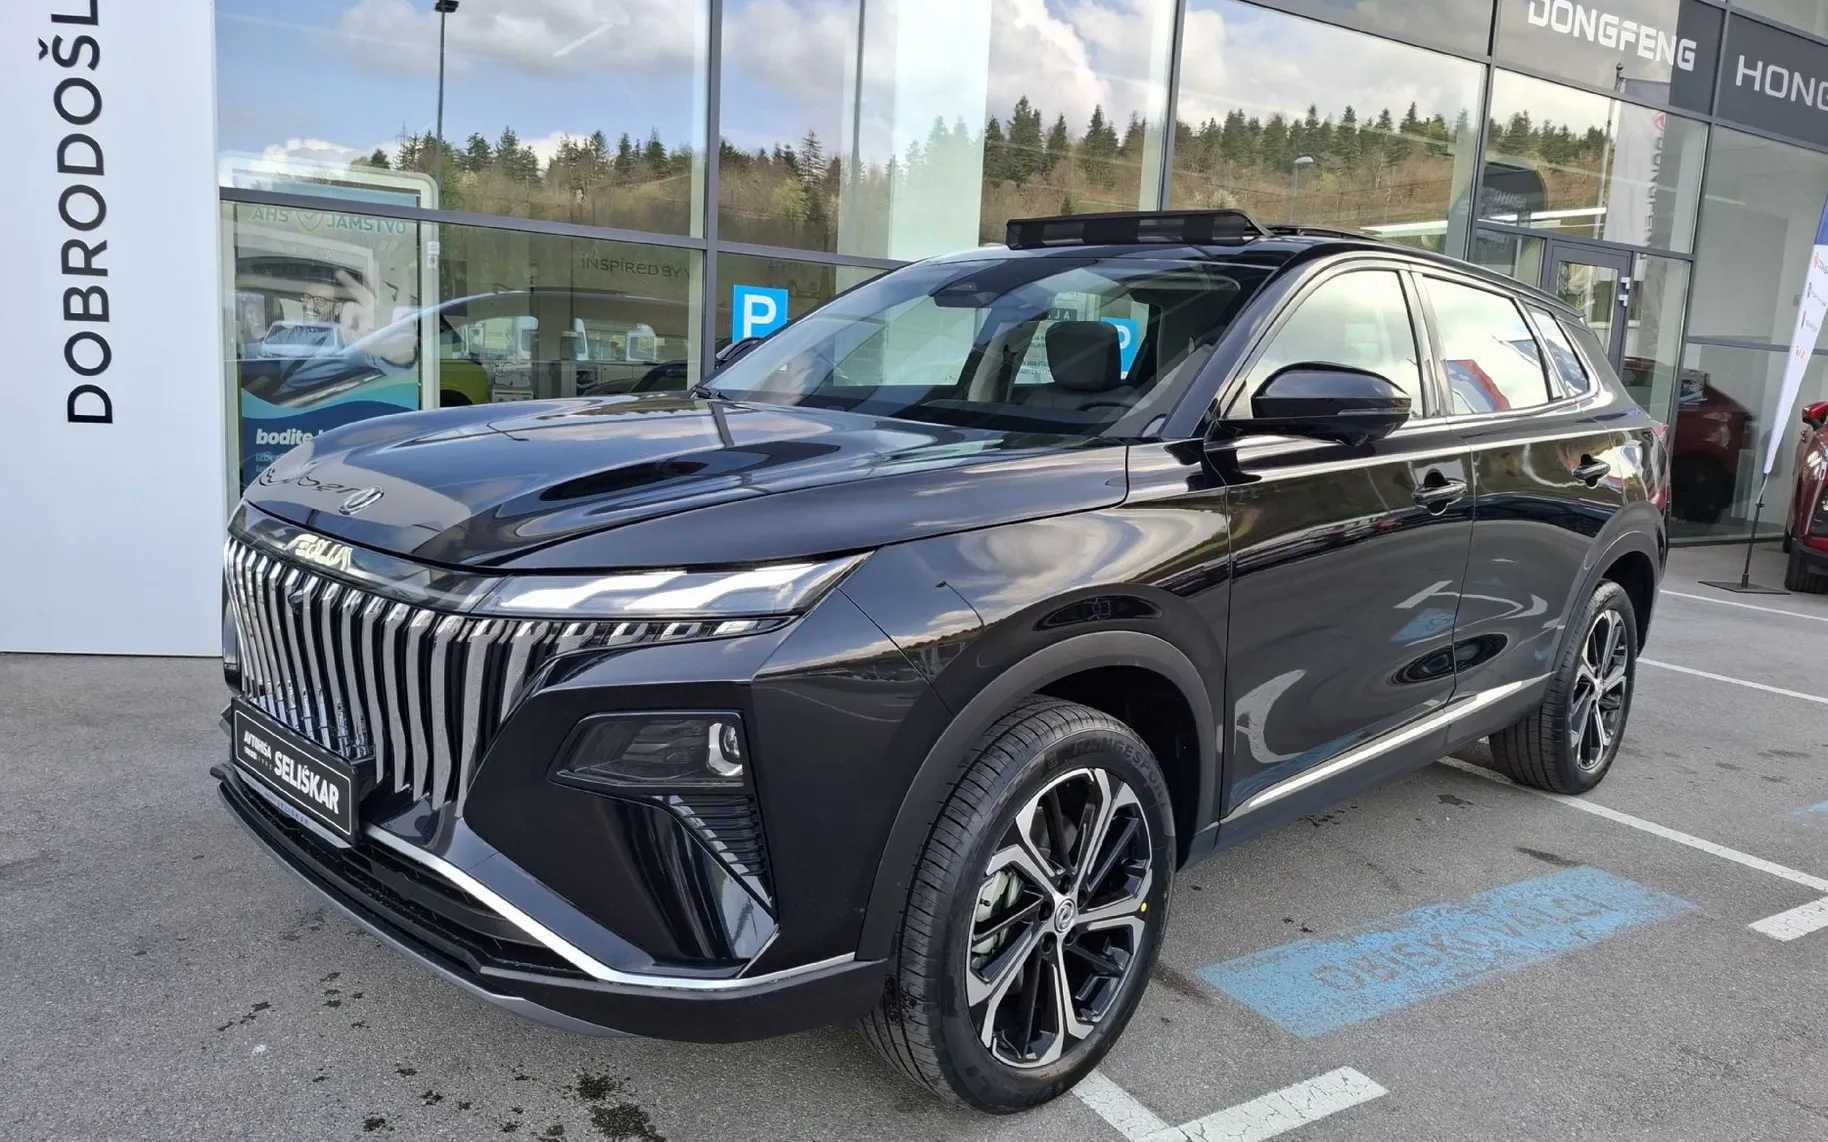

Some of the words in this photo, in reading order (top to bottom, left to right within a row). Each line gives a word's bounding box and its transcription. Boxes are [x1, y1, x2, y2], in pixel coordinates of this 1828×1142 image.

[1527, 0, 1698, 72] DONGFENG
[38, 0, 114, 424] DOBRODOŠL
[251, 206, 290, 223] AHS
[326, 214, 406, 235] JAMSTVO
[743, 293, 777, 339] P
[255, 428, 314, 446] bodite
[274, 751, 340, 815] SELIŠKAR
